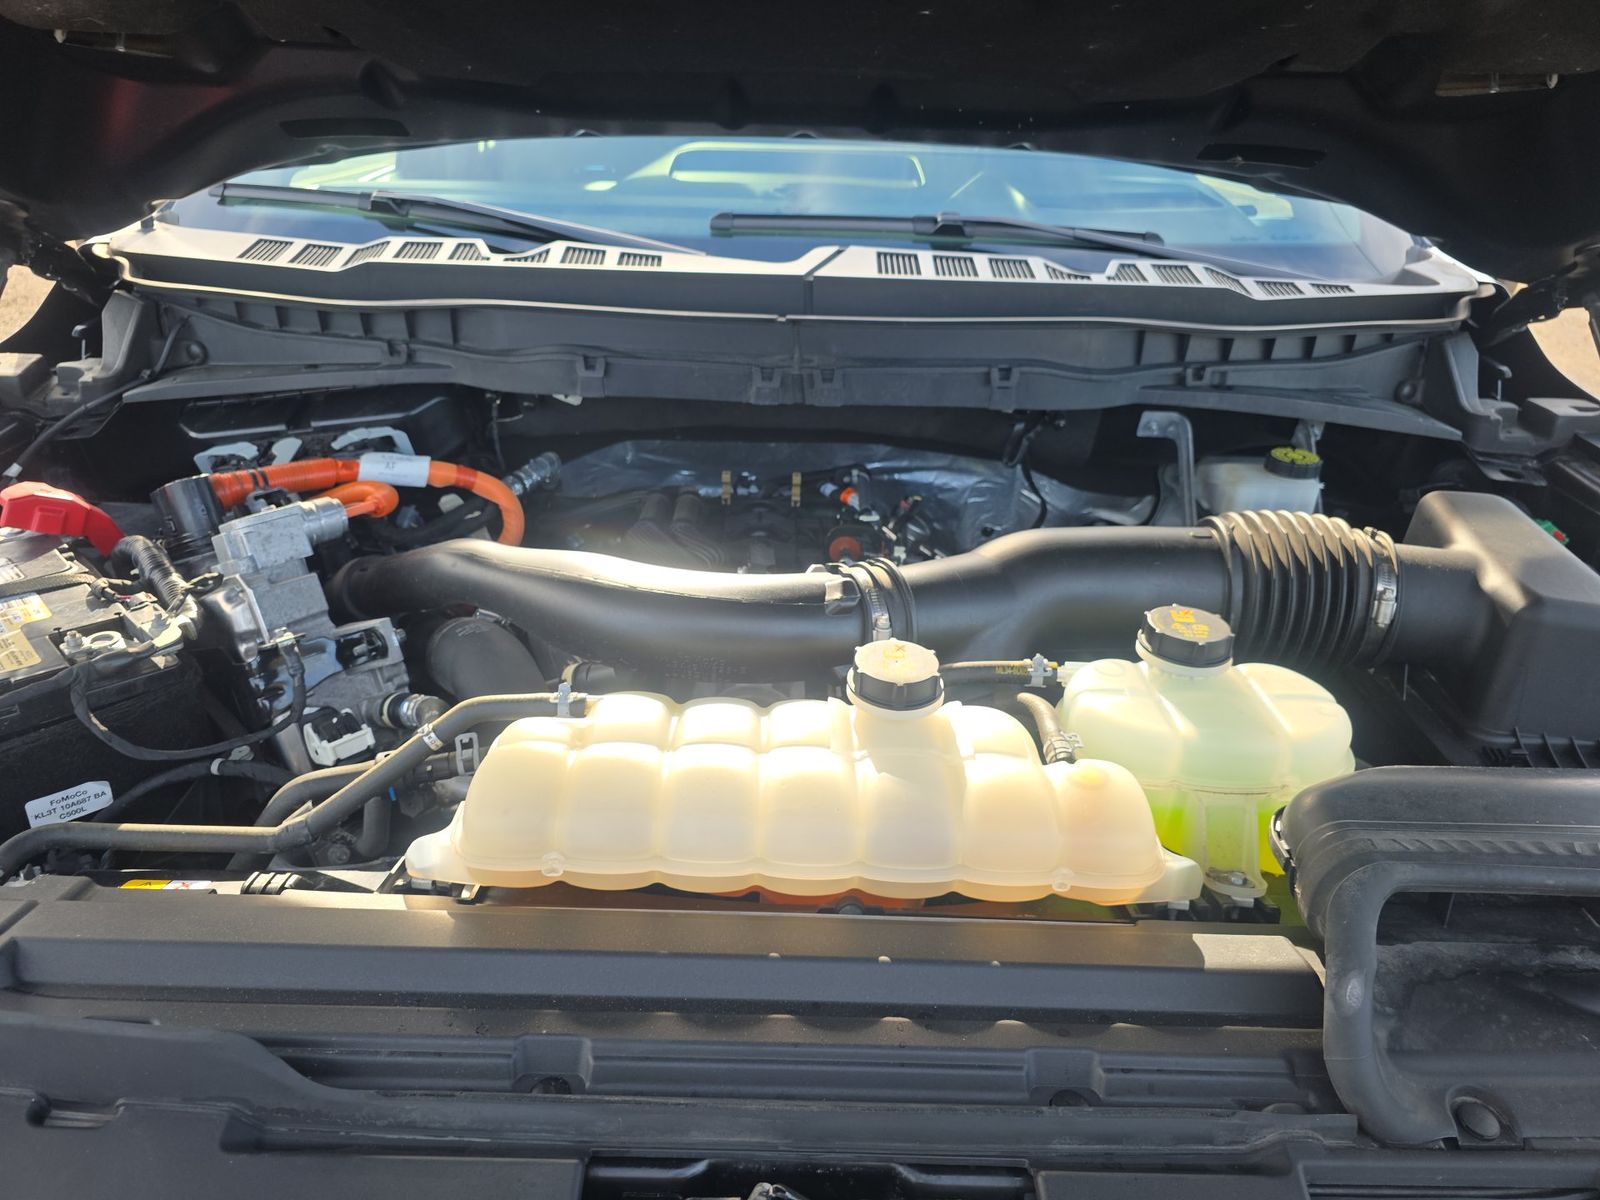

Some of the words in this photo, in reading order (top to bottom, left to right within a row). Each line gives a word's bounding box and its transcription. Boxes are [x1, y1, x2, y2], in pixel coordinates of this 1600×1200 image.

[34, 807, 58, 820] KL3T
[93, 790, 107, 800] BA
[49, 790, 88, 806] FoMoCo
[59, 806, 87, 820] C500L
